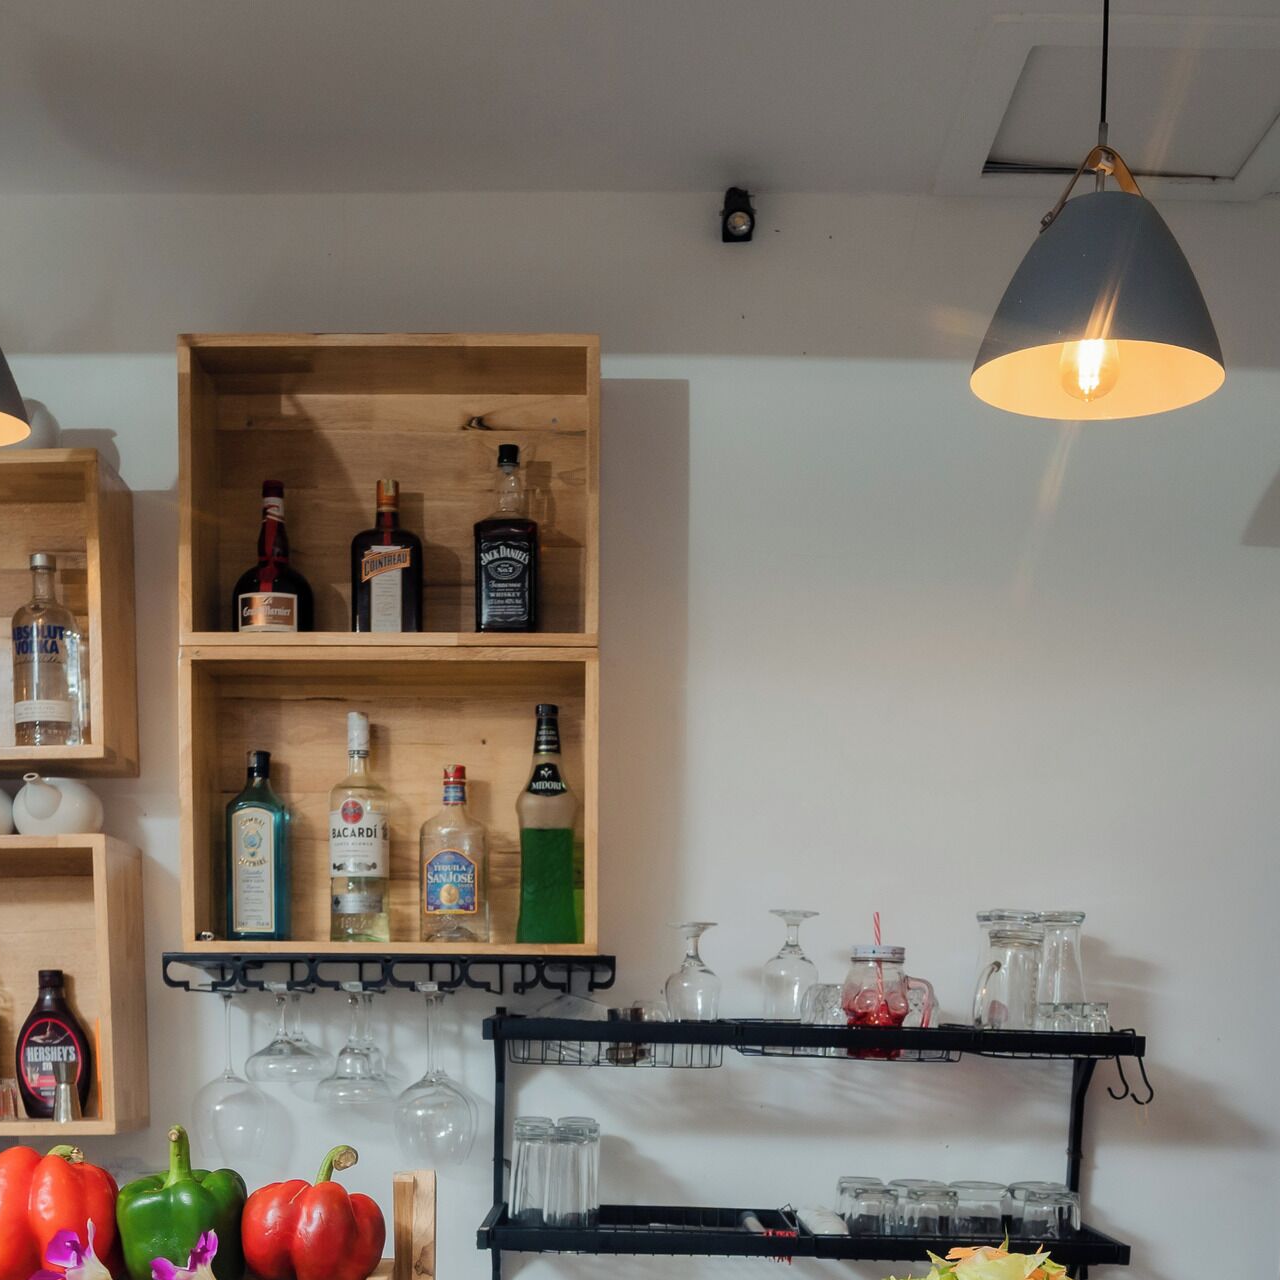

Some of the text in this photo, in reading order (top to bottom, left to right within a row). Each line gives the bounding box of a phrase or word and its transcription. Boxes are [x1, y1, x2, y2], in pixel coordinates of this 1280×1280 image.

[364, 551, 406, 577] COINTREAU
[531, 781, 561, 790] MIDORI
[332, 824, 377, 839] BACARDÍ
[26, 1046, 76, 1062] HERSHEY'S
